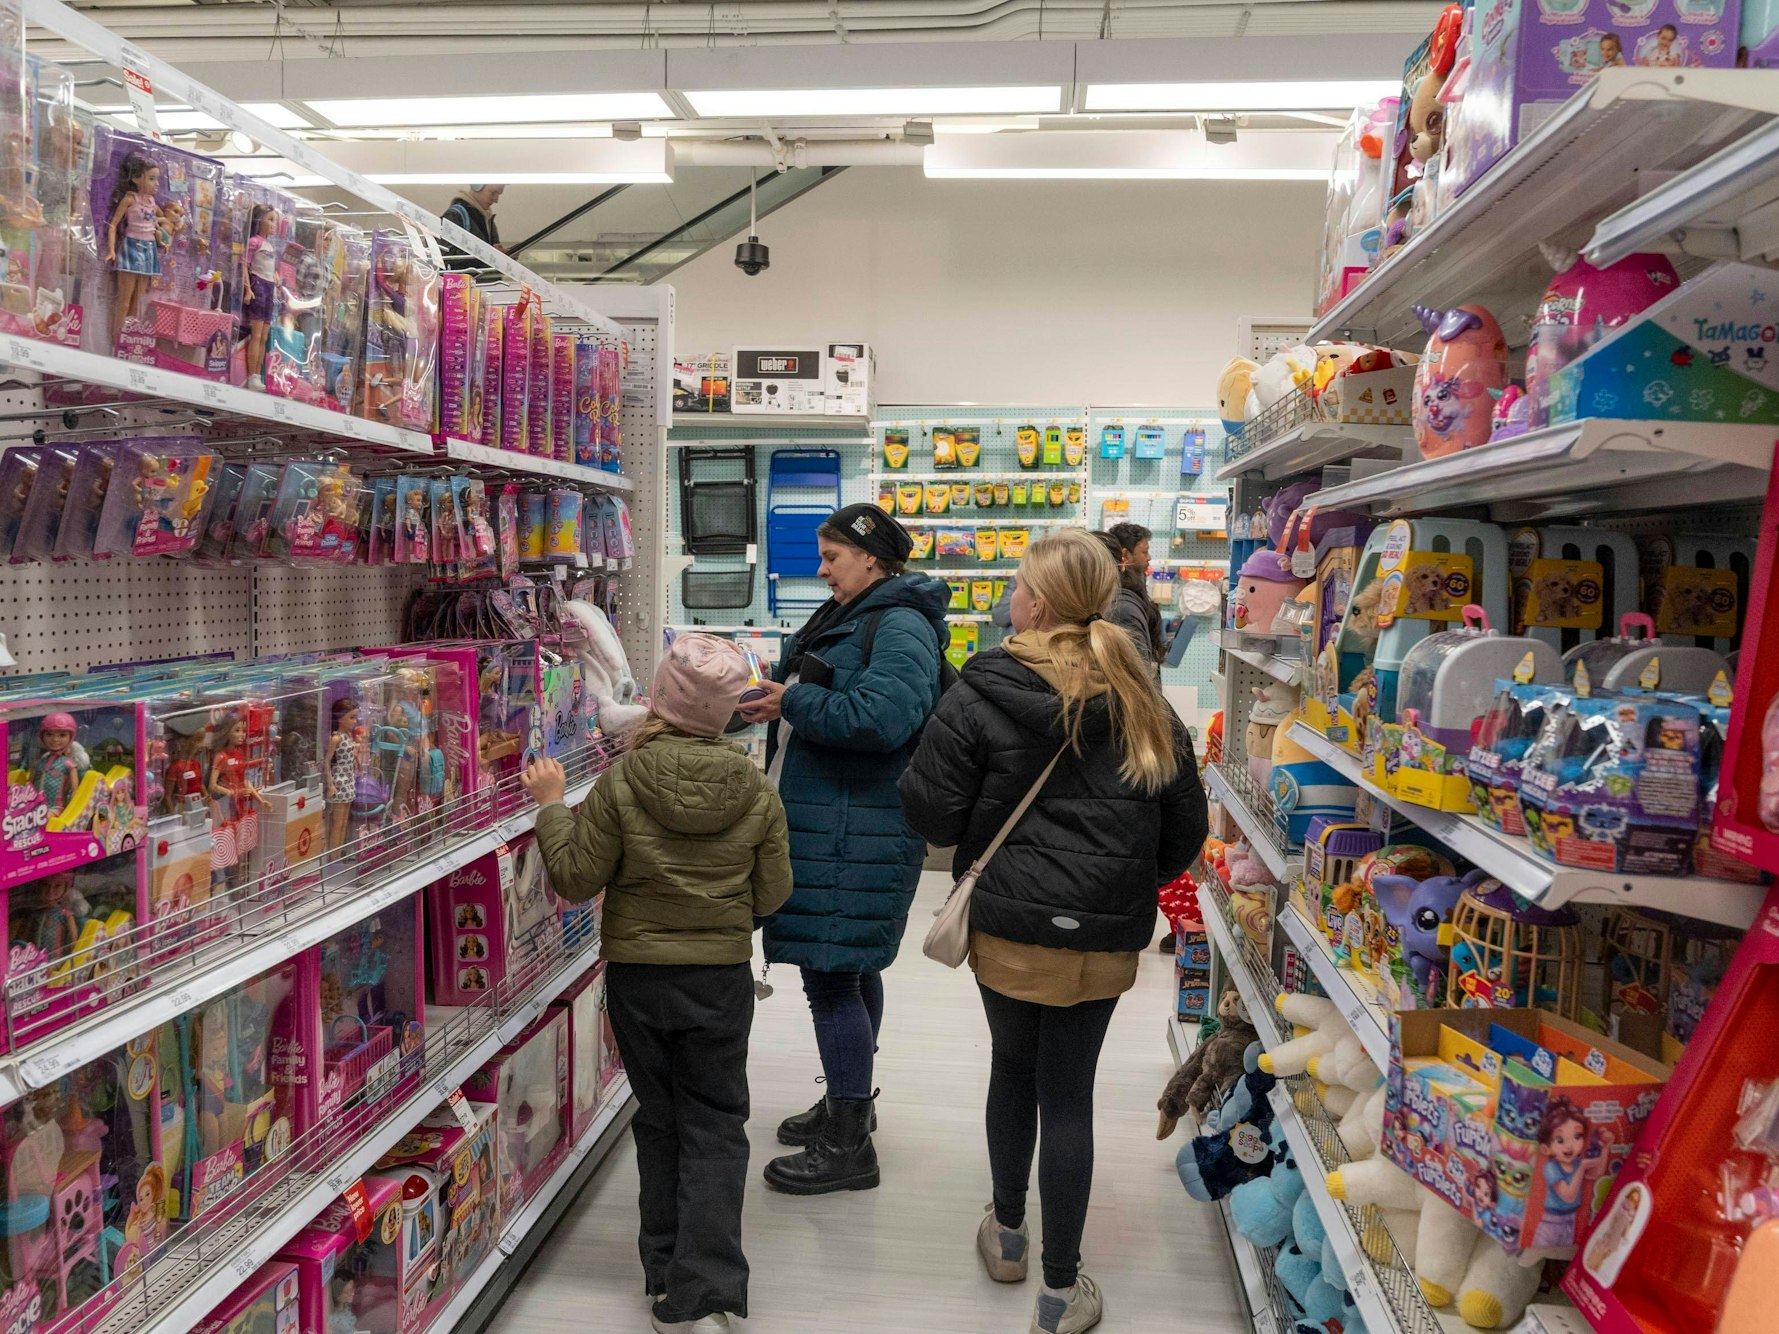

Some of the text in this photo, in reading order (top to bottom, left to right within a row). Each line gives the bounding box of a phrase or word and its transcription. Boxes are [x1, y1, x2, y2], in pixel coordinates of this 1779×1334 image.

[445, 277, 468, 290] Barbie
[120, 333, 157, 348] Family
[133, 345, 144, 355] &
[117, 351, 157, 366] Friends
[760, 358, 788, 371] weber
[855, 519, 867, 531] YOUR
[1449, 579, 1465, 591] 60
[1580, 587, 1596, 597] 60
[554, 710, 577, 744] Barbie
[11, 784, 38, 808] Barbie
[13, 833, 42, 848] RESCUE
[450, 869, 487, 888] Barbie
[10, 944, 38, 970] Barbie
[170, 992, 192, 1007] 22.99
[273, 1036, 304, 1054] Barbie
[38, 1060, 60, 1075] 24.99
[271, 1054, 306, 1066] Family
[284, 1065, 295, 1076] &
[271, 1074, 308, 1085] Friends
[204, 1149, 237, 1182] Barbie
[208, 1171, 237, 1192] TEAM
[347, 1190, 360, 1203] New
[350, 1196, 364, 1211] lower
[353, 1206, 366, 1222] price
[236, 1258, 254, 1276] 22.99
